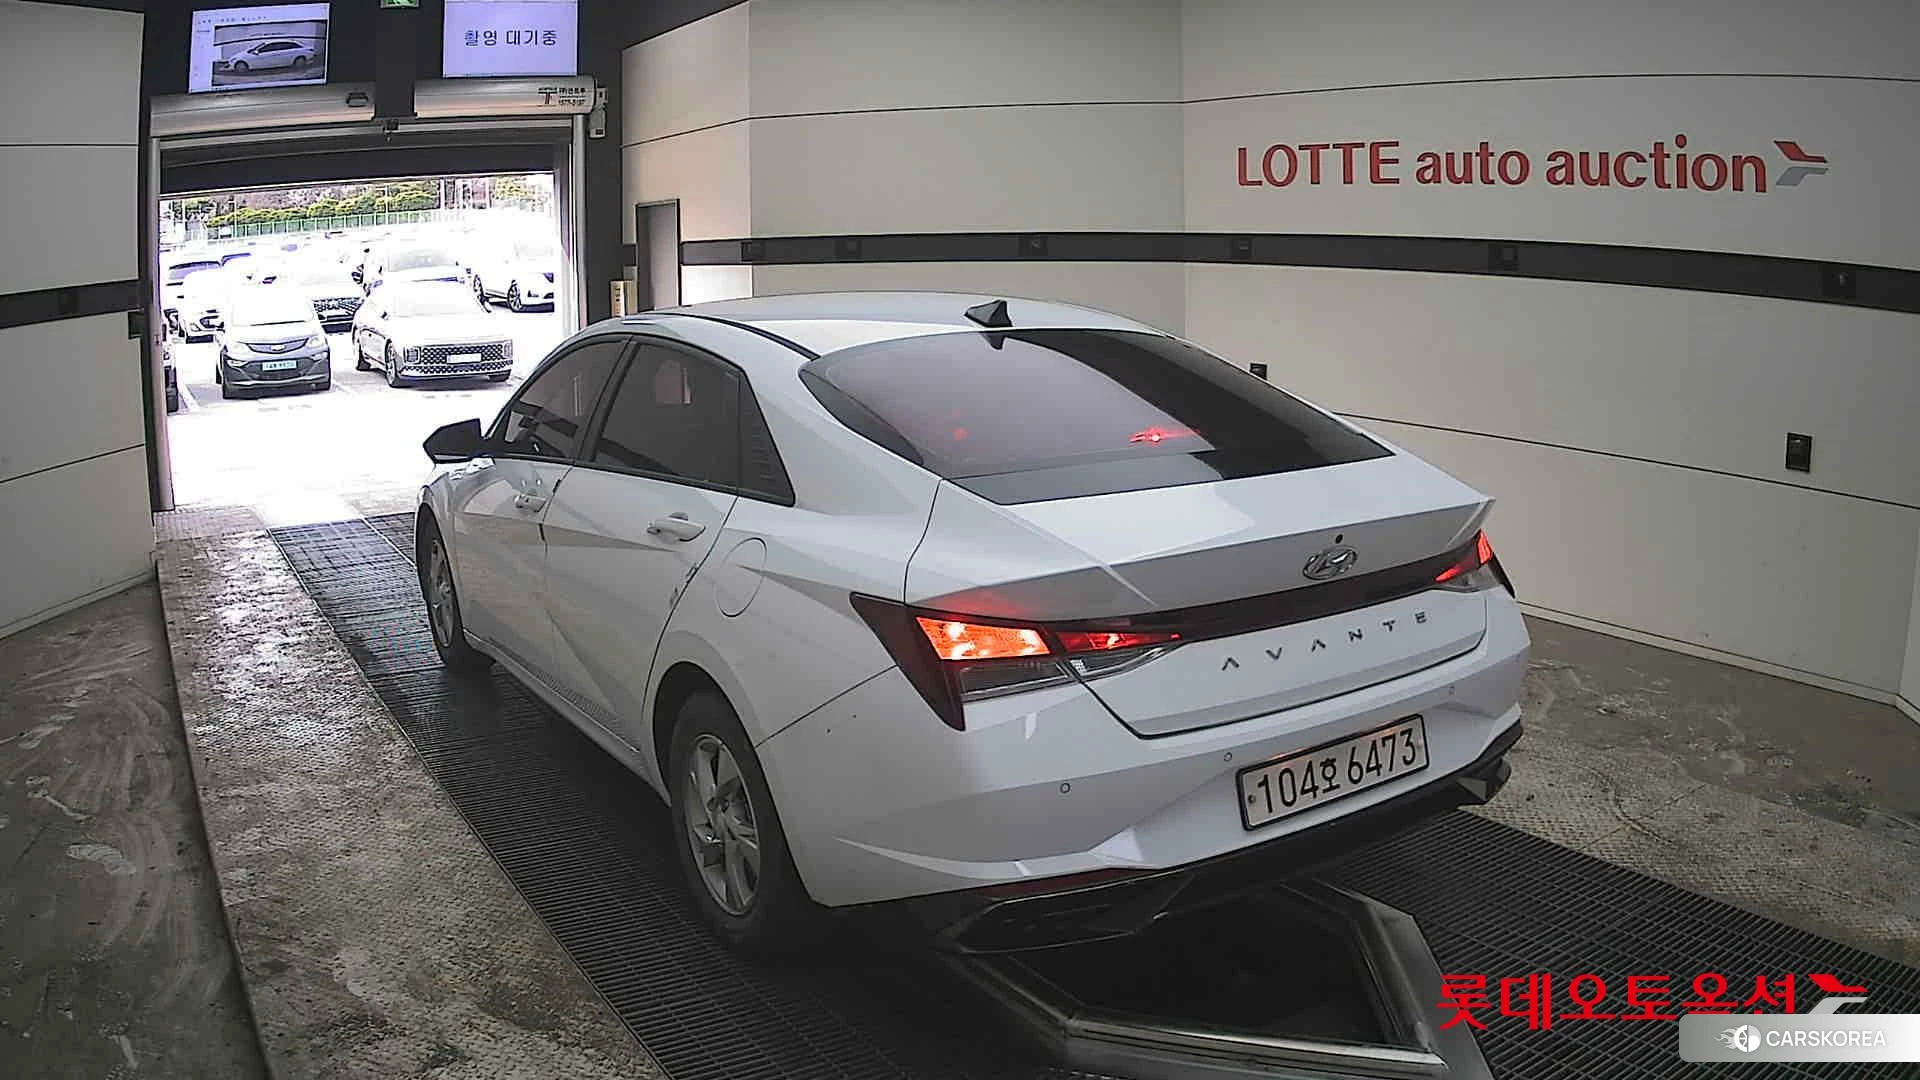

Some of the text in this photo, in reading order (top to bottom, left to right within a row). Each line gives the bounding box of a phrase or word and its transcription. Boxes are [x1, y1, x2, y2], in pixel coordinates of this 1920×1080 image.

[506, 30, 556, 46] 대기중
[1237, 135, 1767, 192] LOTTE auto auction
[1222, 611, 1427, 671] AVANTE
[1257, 728, 1416, 813] 104호 6473
